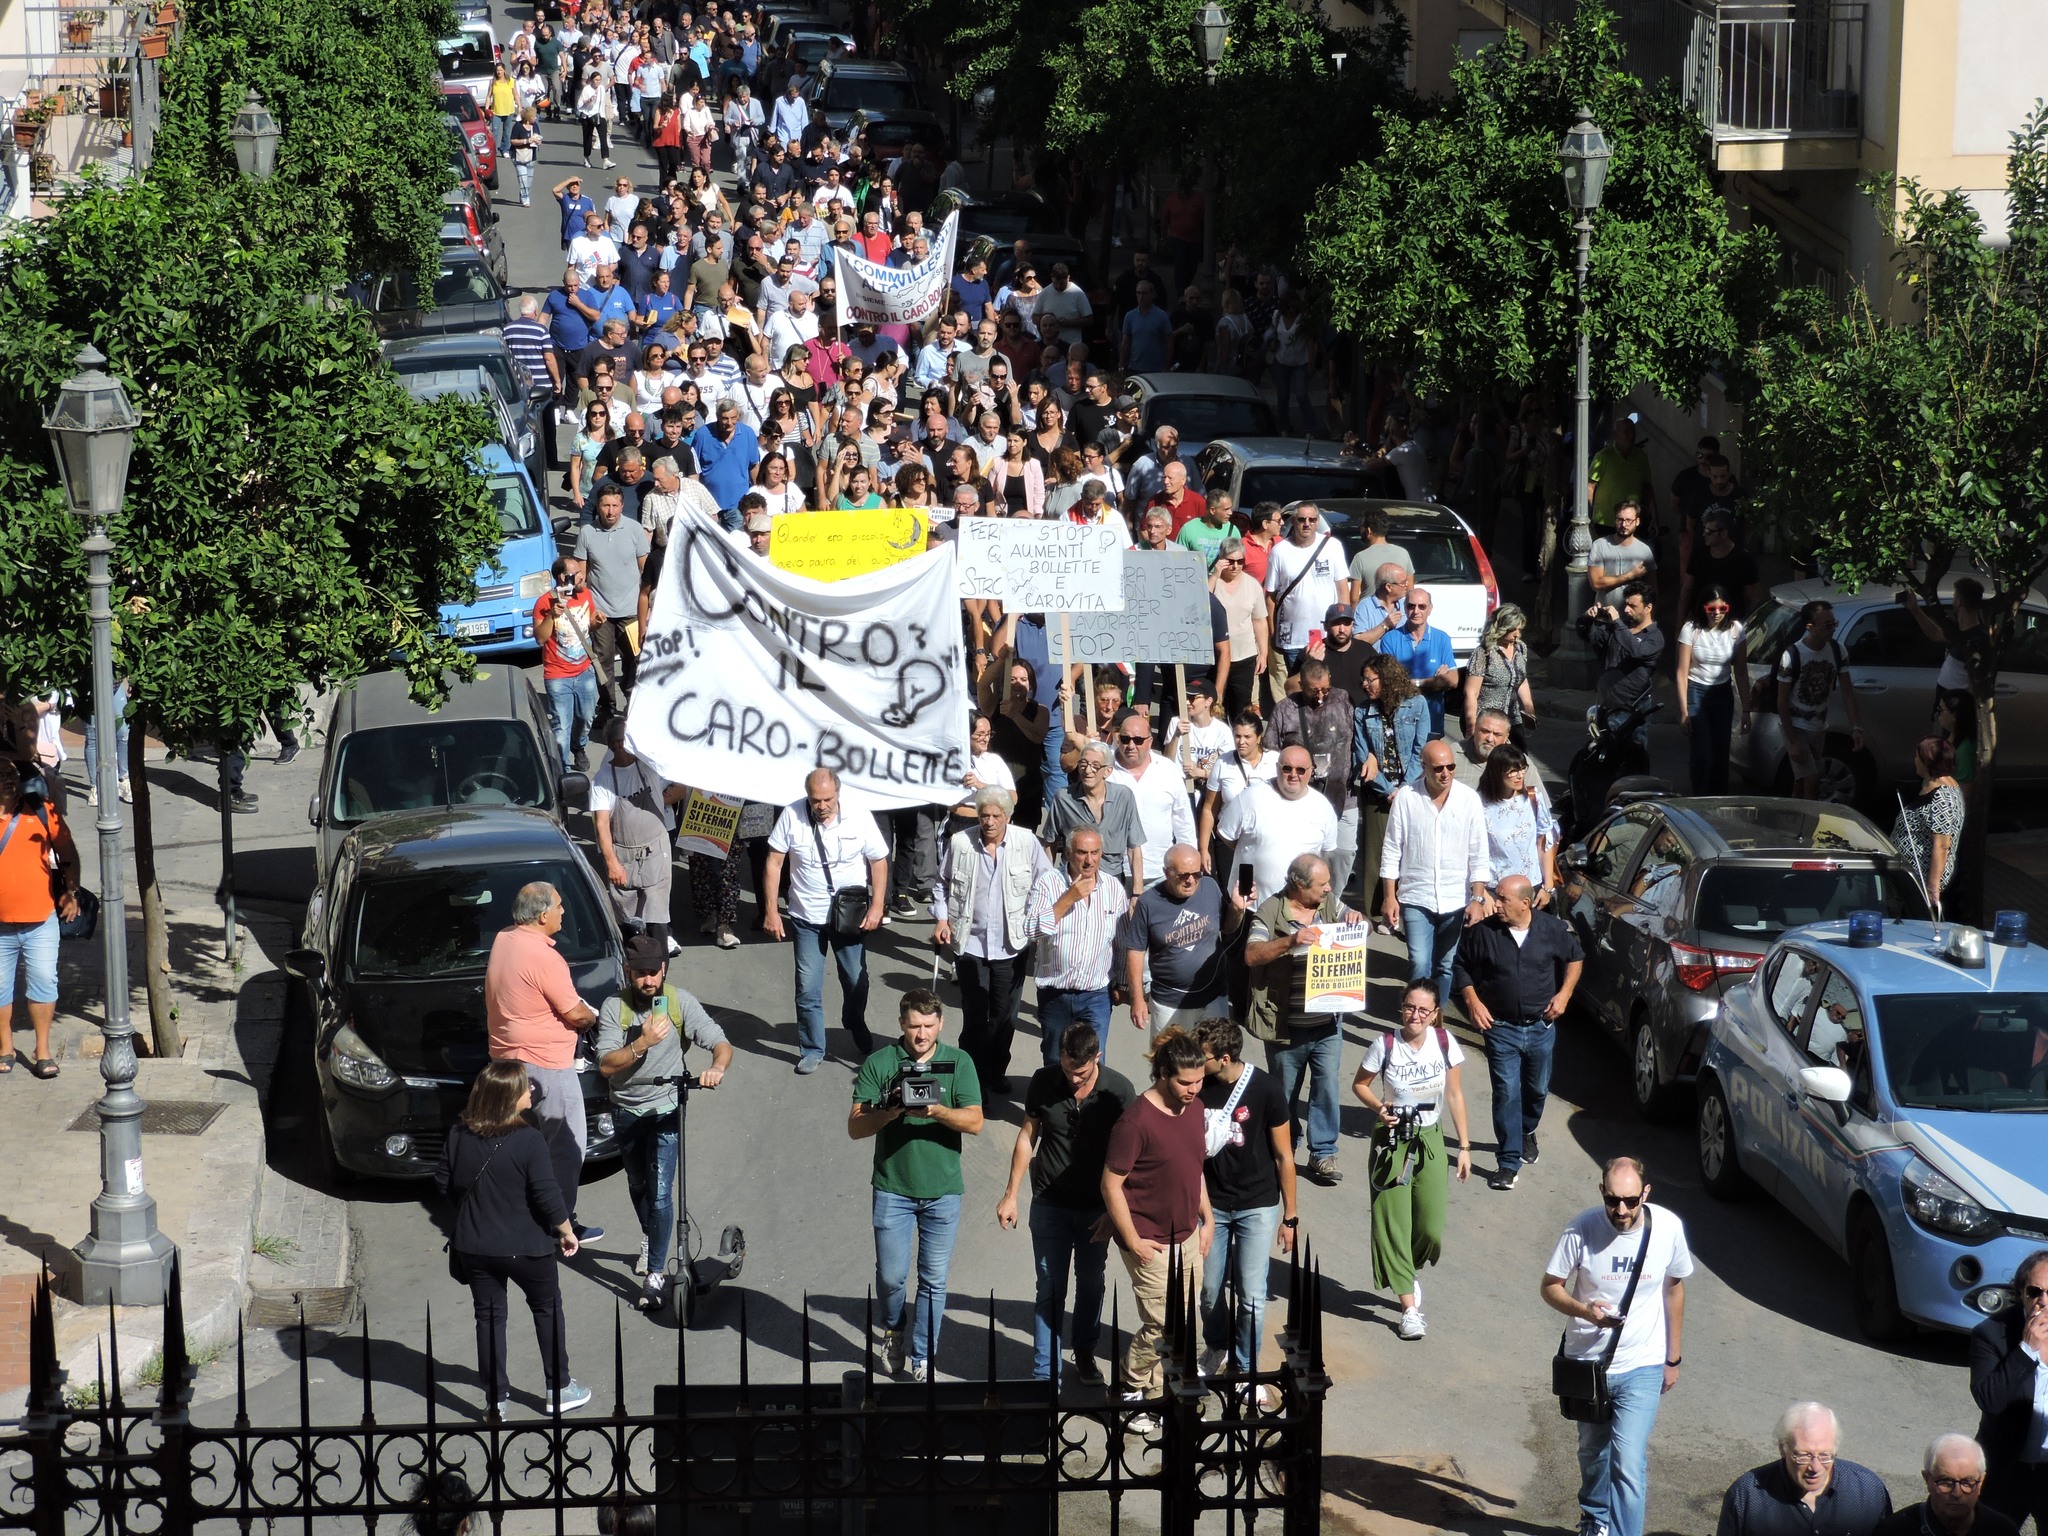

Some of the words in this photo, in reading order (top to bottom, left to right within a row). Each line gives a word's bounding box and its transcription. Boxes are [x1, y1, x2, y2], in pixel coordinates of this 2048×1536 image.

[846, 305, 889, 322] CONTRO
[890, 311, 901, 322] IL
[902, 299, 929, 321] CARO
[827, 533, 843, 543] ero
[968, 520, 1001, 541] FER
[1037, 525, 1093, 542] STOP
[1029, 561, 1101, 575] BOLLETTE
[1160, 567, 1196, 585] PER
[1056, 576, 1065, 590] E
[1123, 583, 1146, 599] ON
[1160, 584, 1176, 599] SI
[680, 521, 899, 668] CONTRO
[1127, 598, 1161, 616] PER
[639, 626, 700, 665] STOP!
[1051, 632, 1115, 657] STOP
[1126, 631, 1149, 648] AL
[1157, 631, 1201, 650] CARO
[1120, 647, 1215, 663] BOLLETTE
[778, 651, 826, 693] IL
[1178, 744, 1217, 756] eenka
[691, 800, 738, 819] BAGHERIA
[685, 823, 702, 833] CARO
[688, 809, 700, 822] SI
[700, 812, 734, 830] FERMA
[1340, 932, 1363, 941] OTTOBRE
[1312, 949, 1364, 965] BAGHERIA
[1311, 964, 1324, 978] SI
[1327, 961, 1363, 978] FERMA
[1310, 982, 1330, 990] CARO
[1332, 980, 1362, 989] BOLLETTE
[1729, 1068, 1828, 1188] POLIZIA
